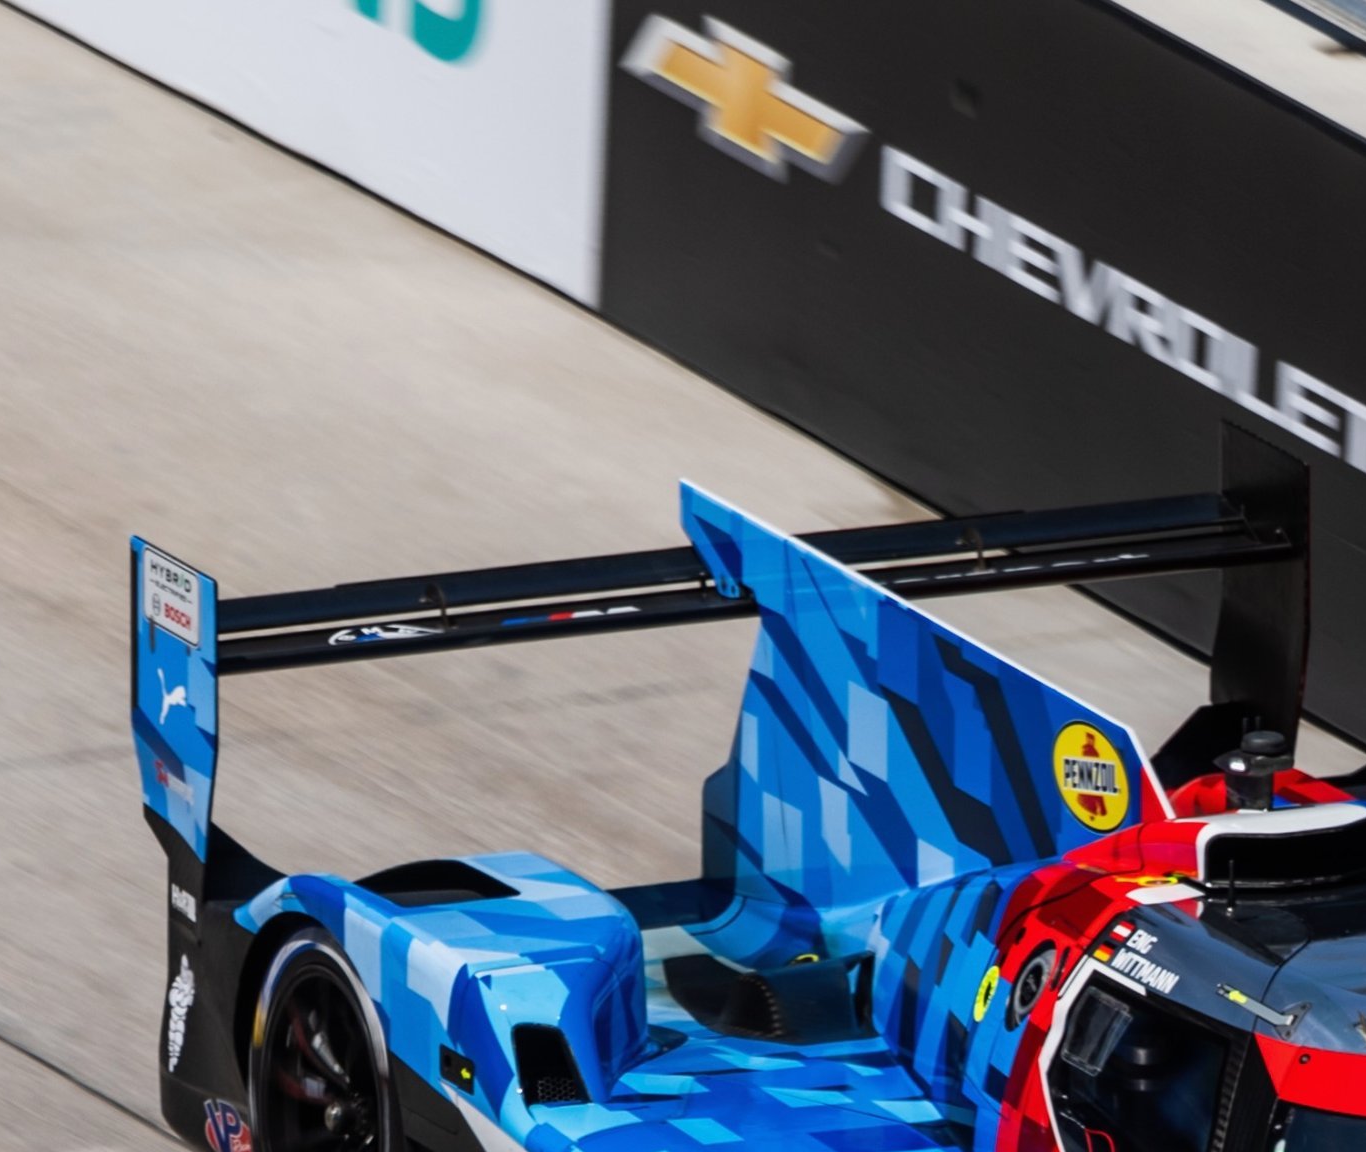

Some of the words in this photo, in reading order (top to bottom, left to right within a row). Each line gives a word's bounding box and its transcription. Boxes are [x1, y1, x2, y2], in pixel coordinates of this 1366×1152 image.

[163, 601, 192, 632] BOSCH
[1062, 757, 1120, 796] PENNZOIL
[1127, 927, 1158, 954] ENG
[1111, 947, 1180, 995] WITTMANN
